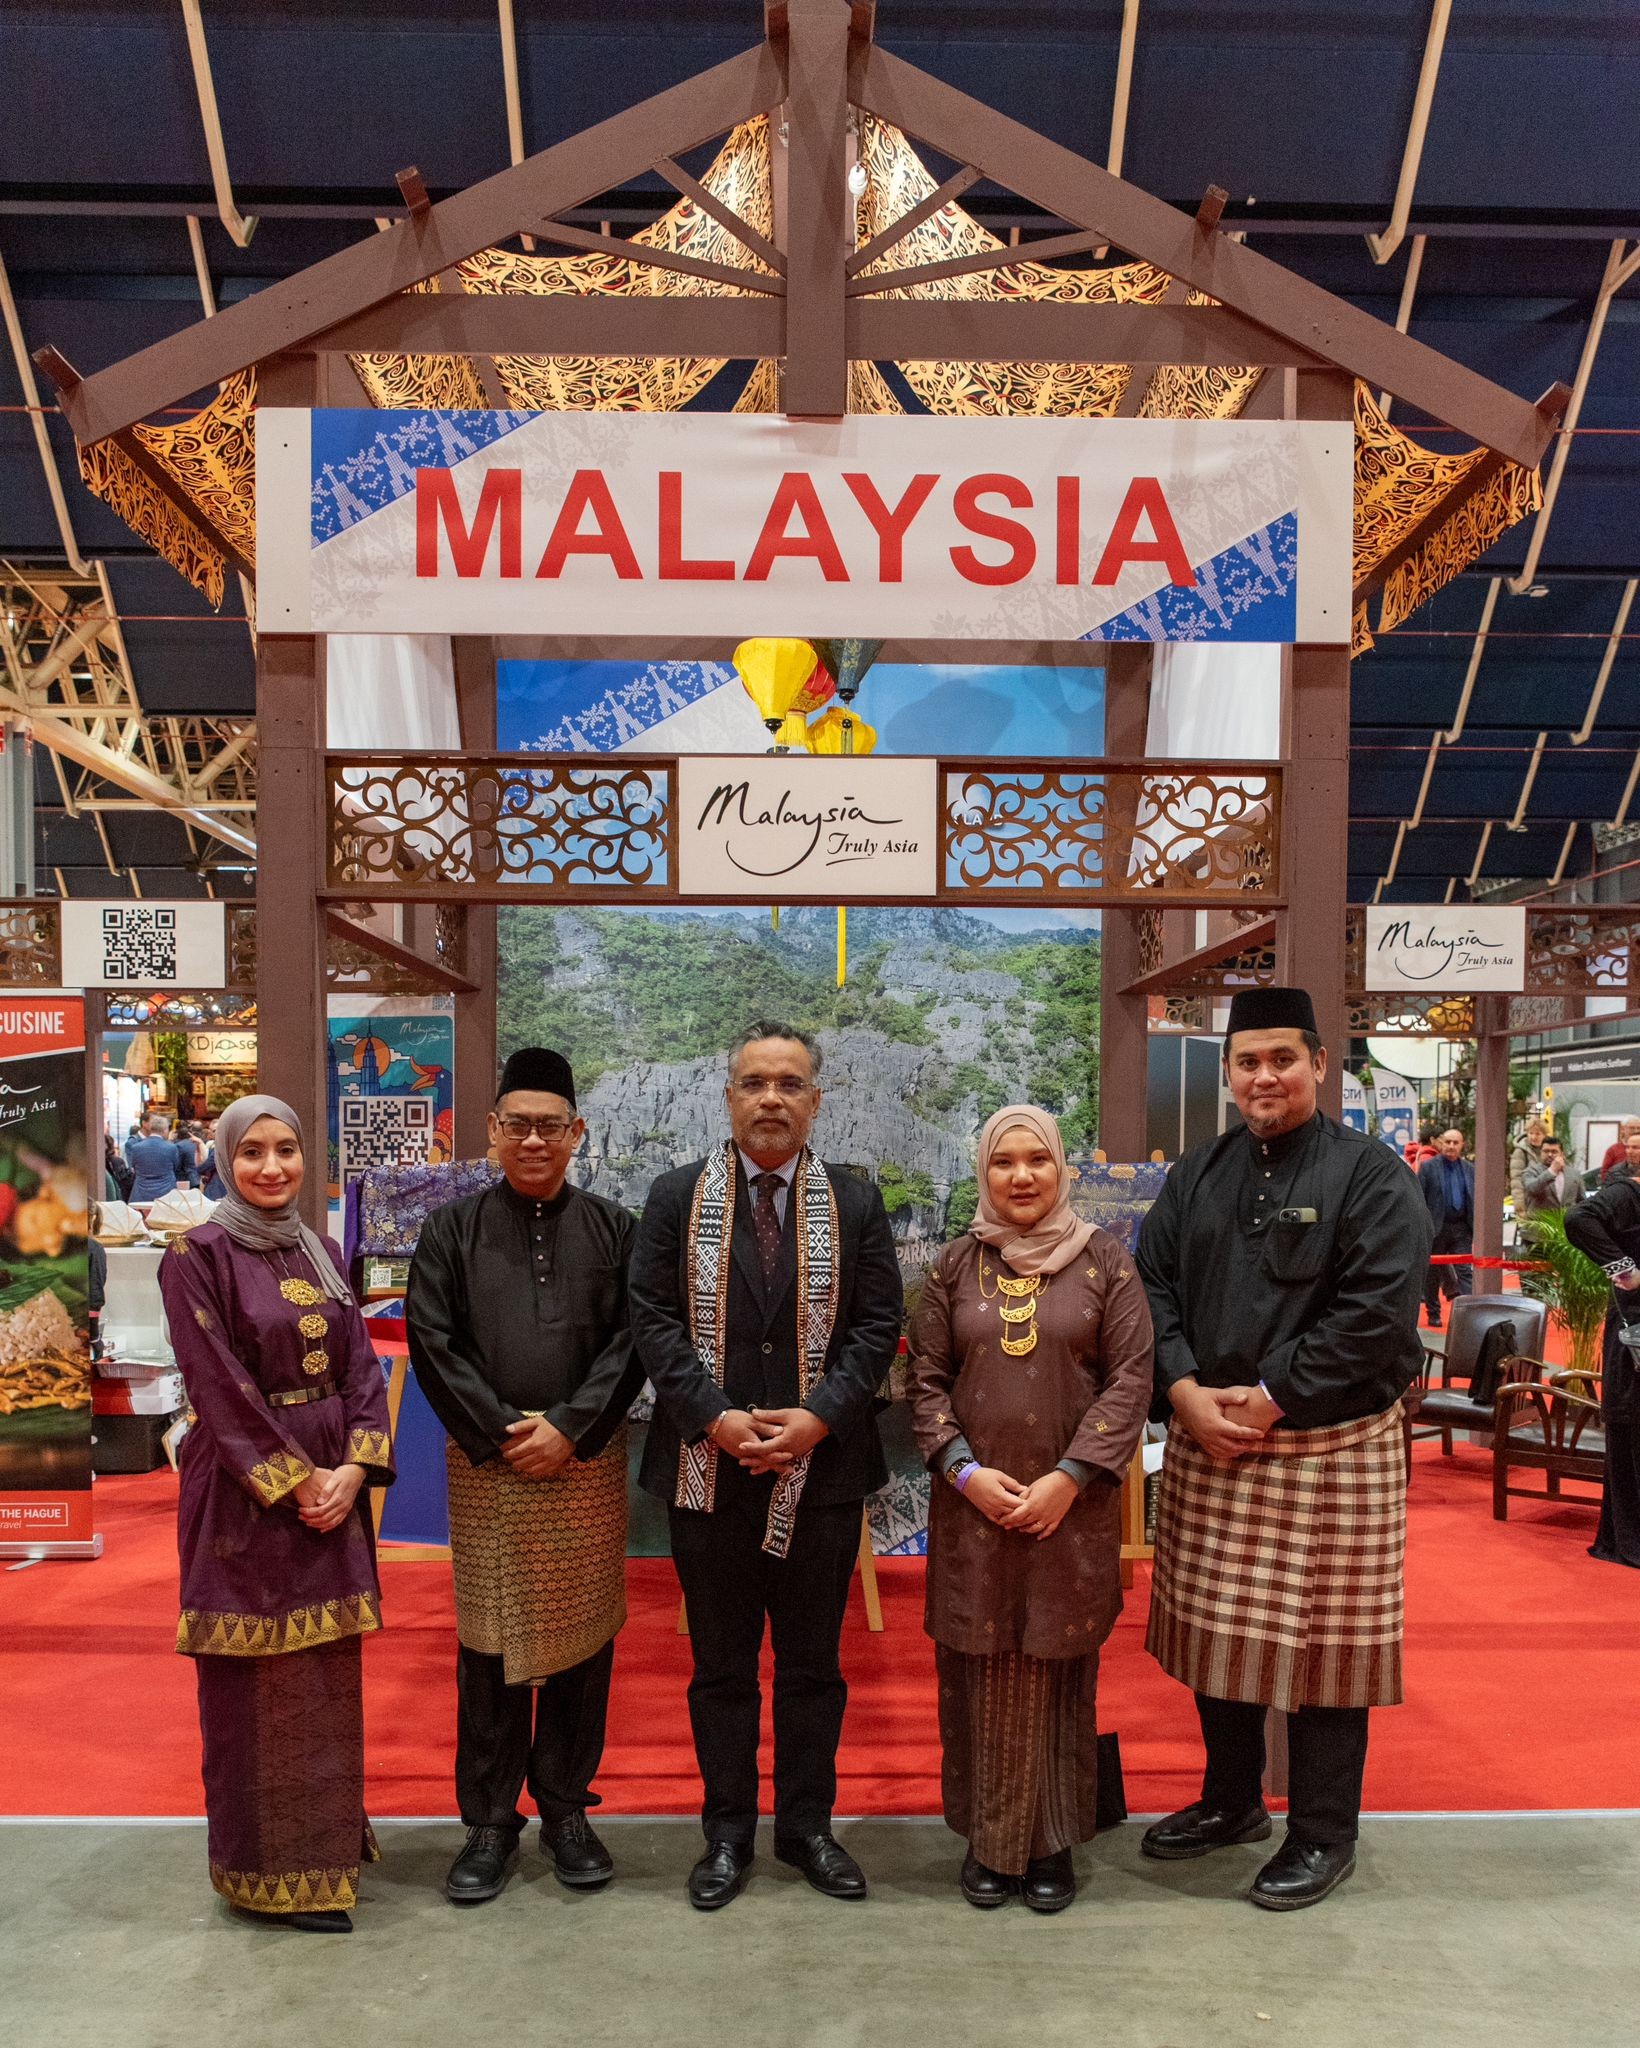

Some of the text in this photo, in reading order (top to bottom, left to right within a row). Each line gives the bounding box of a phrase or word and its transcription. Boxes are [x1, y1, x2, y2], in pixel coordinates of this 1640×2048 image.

[415, 467, 1198, 587] MALAYSIA
[698, 781, 903, 877] Malaysia
[827, 832, 918, 857] Truly Asia
[1378, 921, 1504, 980] Malaysia
[1456, 952, 1513, 968] Truly Asia
[31, 1098, 57, 1113] Asia
[1, 1508, 61, 1518] THE HAGUE
[0, 1520, 21, 1529] ravel
